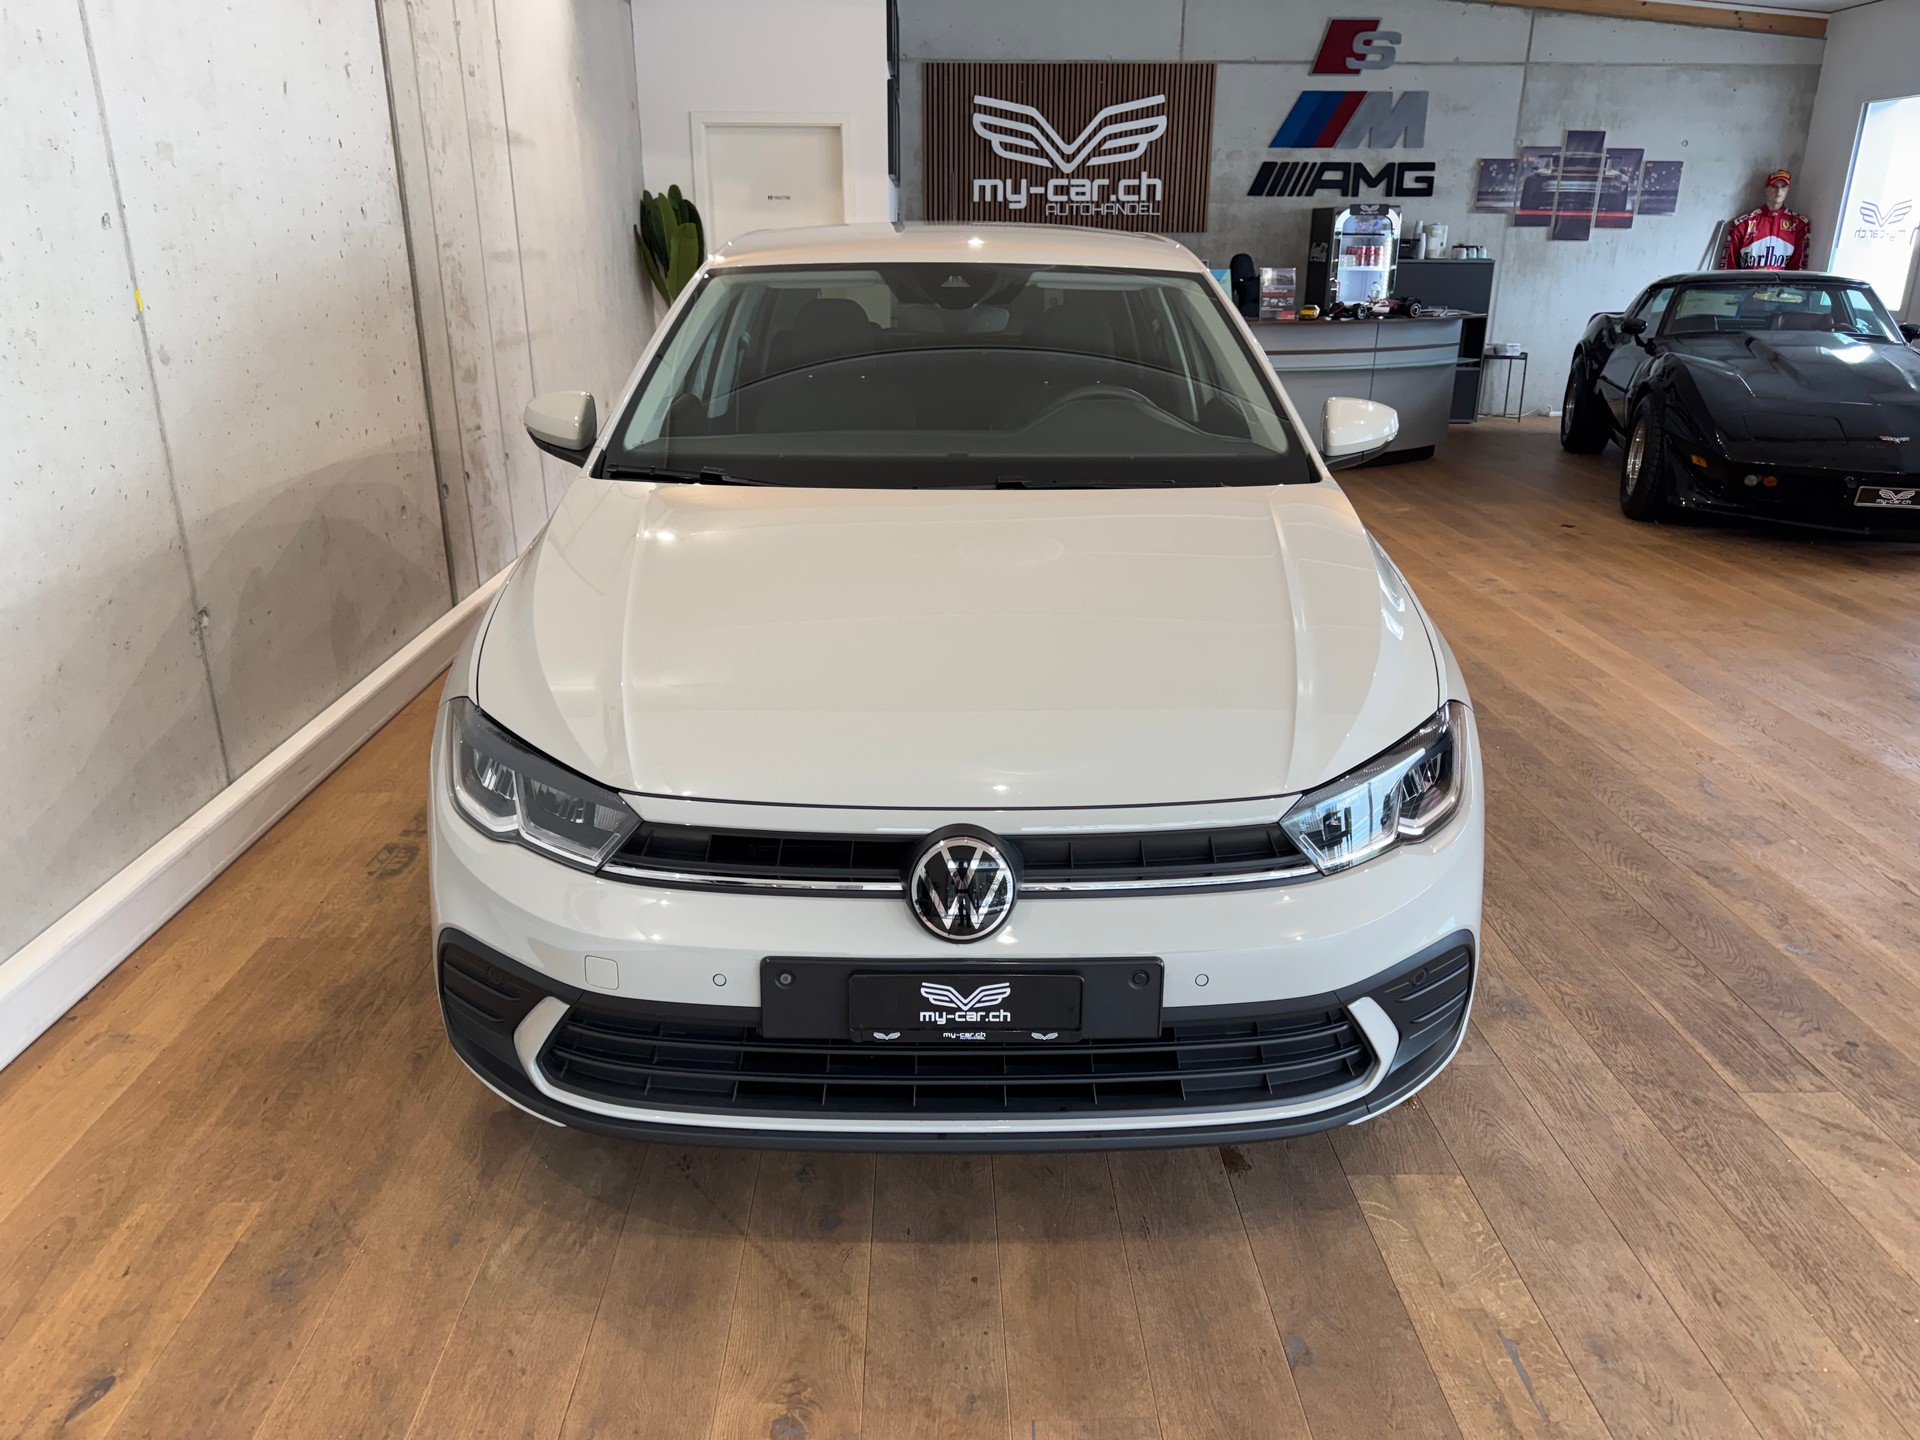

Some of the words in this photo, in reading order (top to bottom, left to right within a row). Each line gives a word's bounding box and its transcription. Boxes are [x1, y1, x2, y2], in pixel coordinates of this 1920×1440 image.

[1345, 31, 1402, 70] S
[1335, 91, 1429, 149] M
[973, 171, 1162, 210] my-car.ch
[1304, 162, 1436, 198] AMG
[1045, 202, 1161, 217] AUTOHANDEL
[1741, 246, 1791, 267] Marlbor
[919, 1009, 1011, 1025] my-car.ch
